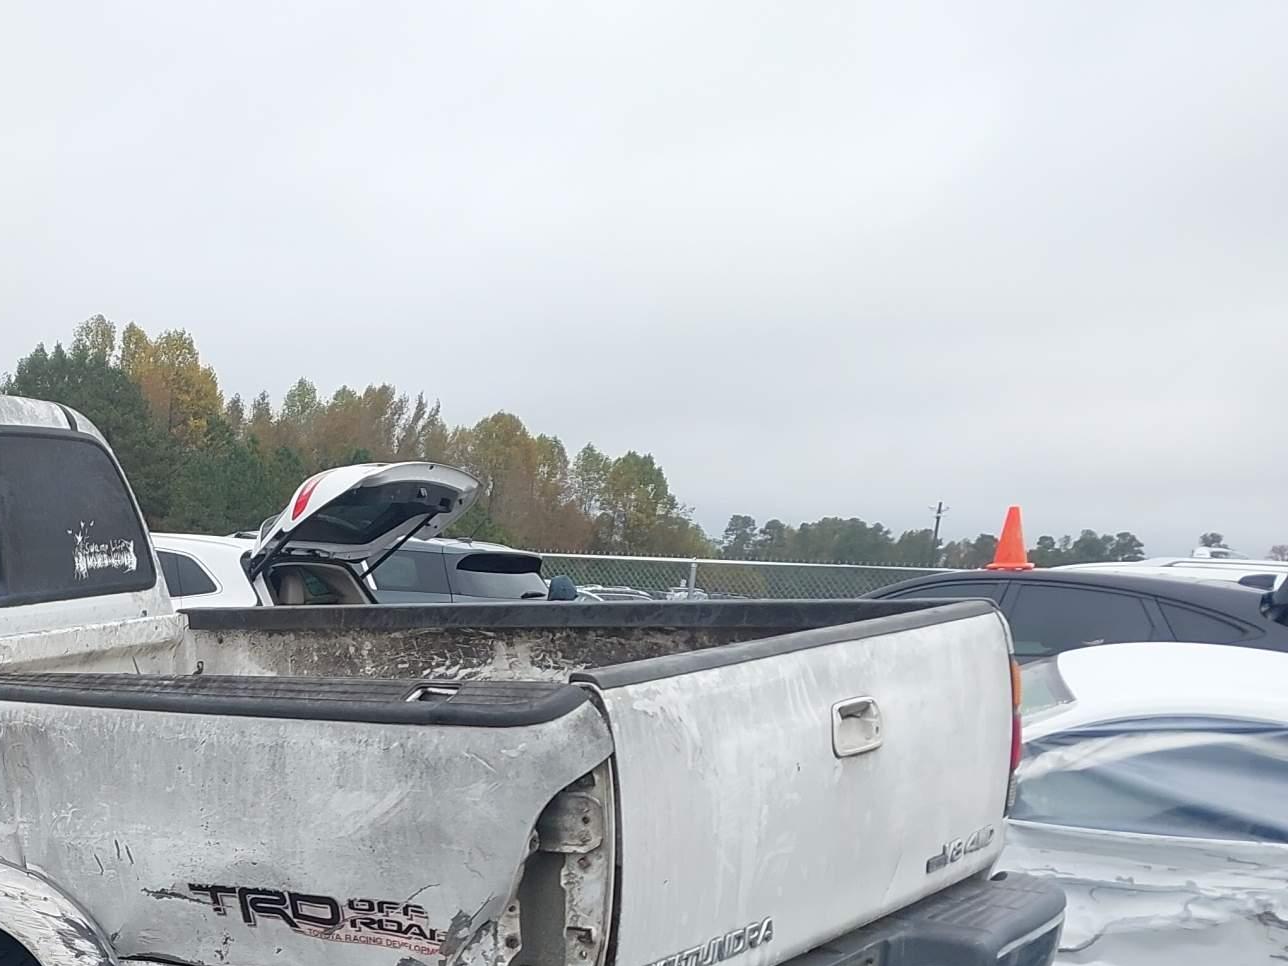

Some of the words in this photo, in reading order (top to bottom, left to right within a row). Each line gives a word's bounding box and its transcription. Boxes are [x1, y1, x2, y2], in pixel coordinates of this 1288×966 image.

[188, 883, 342, 928] TRD
[347, 898, 426, 920] OFF
[345, 933, 383, 945] RACING
